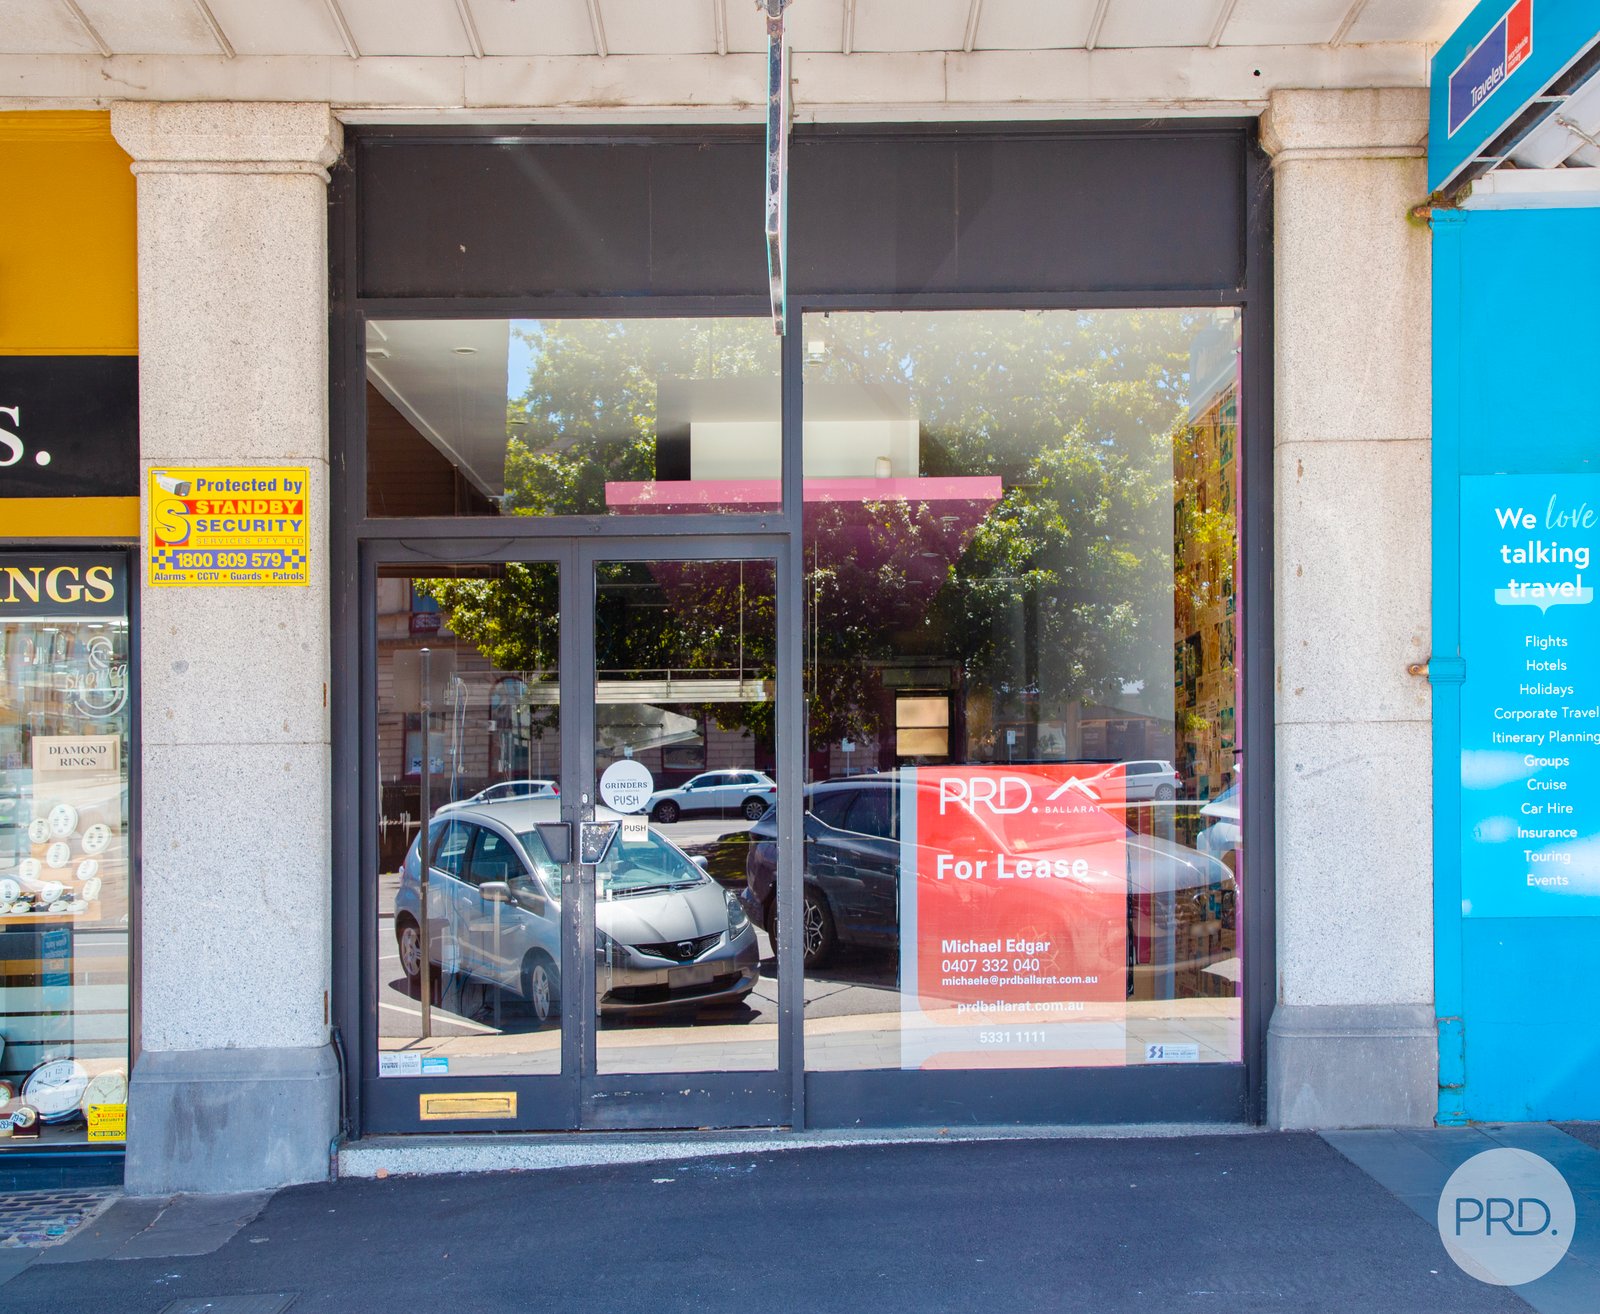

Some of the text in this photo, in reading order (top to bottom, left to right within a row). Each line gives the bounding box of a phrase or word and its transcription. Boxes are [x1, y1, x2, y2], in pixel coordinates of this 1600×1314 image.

[1470, 62, 1504, 107] Travelex
[196, 478, 303, 494] Protected by
[195, 500, 298, 514] STANDBY
[1494, 493, 1599, 530] We love
[196, 519, 303, 532] SECURITY
[176, 553, 282, 568] 1800 809 579
[1500, 540, 1590, 569] talking
[154, 571, 304, 581] Alarms CCTV Guards Patrols
[0, 566, 115, 603] NGS
[1508, 573, 1582, 598] travel
[1525, 634, 1568, 650] Flights
[1526, 658, 1567, 671] Hotels
[1520, 682, 1574, 697] Holidays
[1494, 705, 1600, 722] Corporate Travel
[1492, 730, 1600, 746] Itinerary Planning
[49, 745, 107, 755] DIAMOND
[60, 757, 97, 767] RINGS
[1524, 754, 1570, 769] Groups
[605, 781, 648, 789] GRINDERS
[1527, 778, 1567, 790] Cruise
[613, 795, 639, 805] PUSH
[939, 776, 1039, 815] PRD.
[1045, 805, 1101, 814] BALLARAT
[1521, 802, 1573, 814] Car Hire
[1517, 826, 1578, 838] Insurance
[1524, 850, 1571, 864] Touring
[937, 853, 1089, 880] For Lease
[1527, 874, 1569, 886] Events
[941, 939, 1051, 954] Michael Edgar
[941, 958, 1040, 972] 0407 332 040
[942, 975, 1098, 987] michaele@prdballarat.com.au
[957, 1000, 1085, 1014] prdballarat.com.au
[980, 1031, 1046, 1043] 5331 1111
